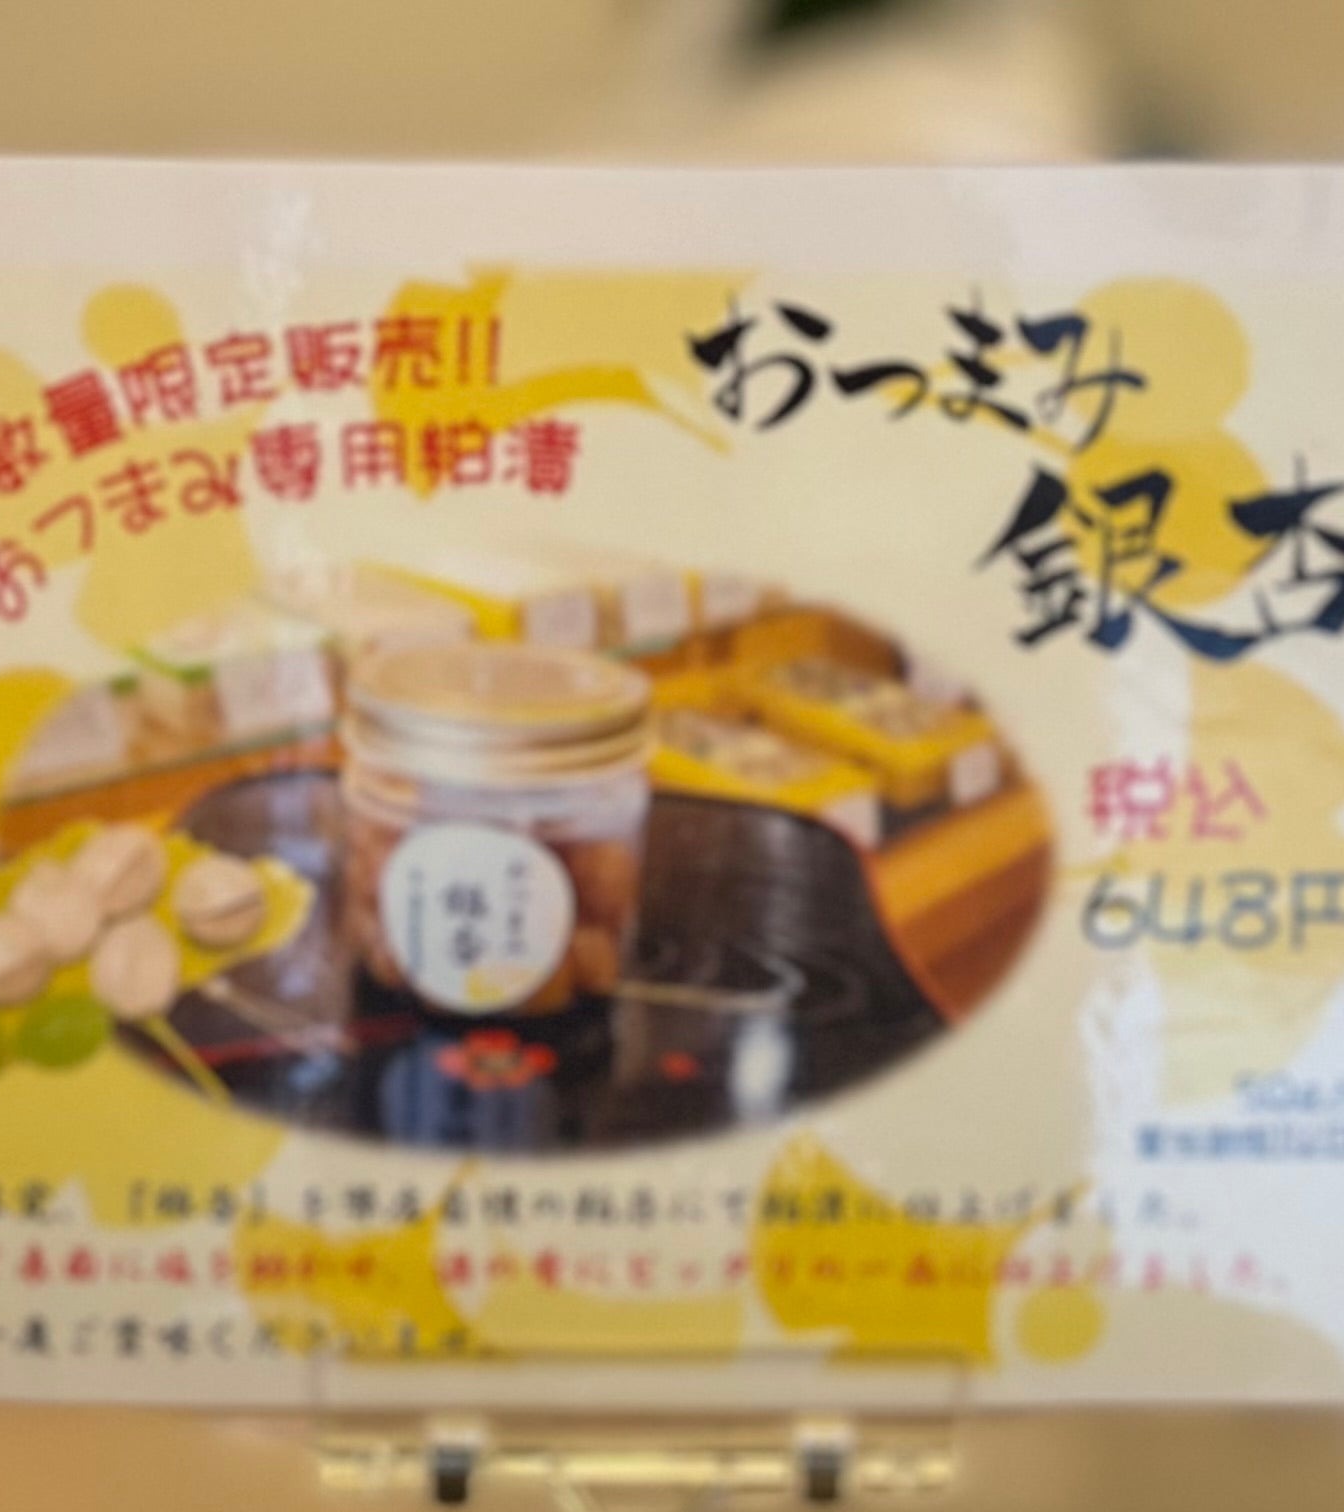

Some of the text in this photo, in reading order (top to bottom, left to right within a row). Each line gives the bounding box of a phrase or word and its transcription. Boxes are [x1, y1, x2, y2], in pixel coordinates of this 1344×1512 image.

[683, 288, 1148, 454] おつまみ
[1085, 757, 1268, 841] 税込
